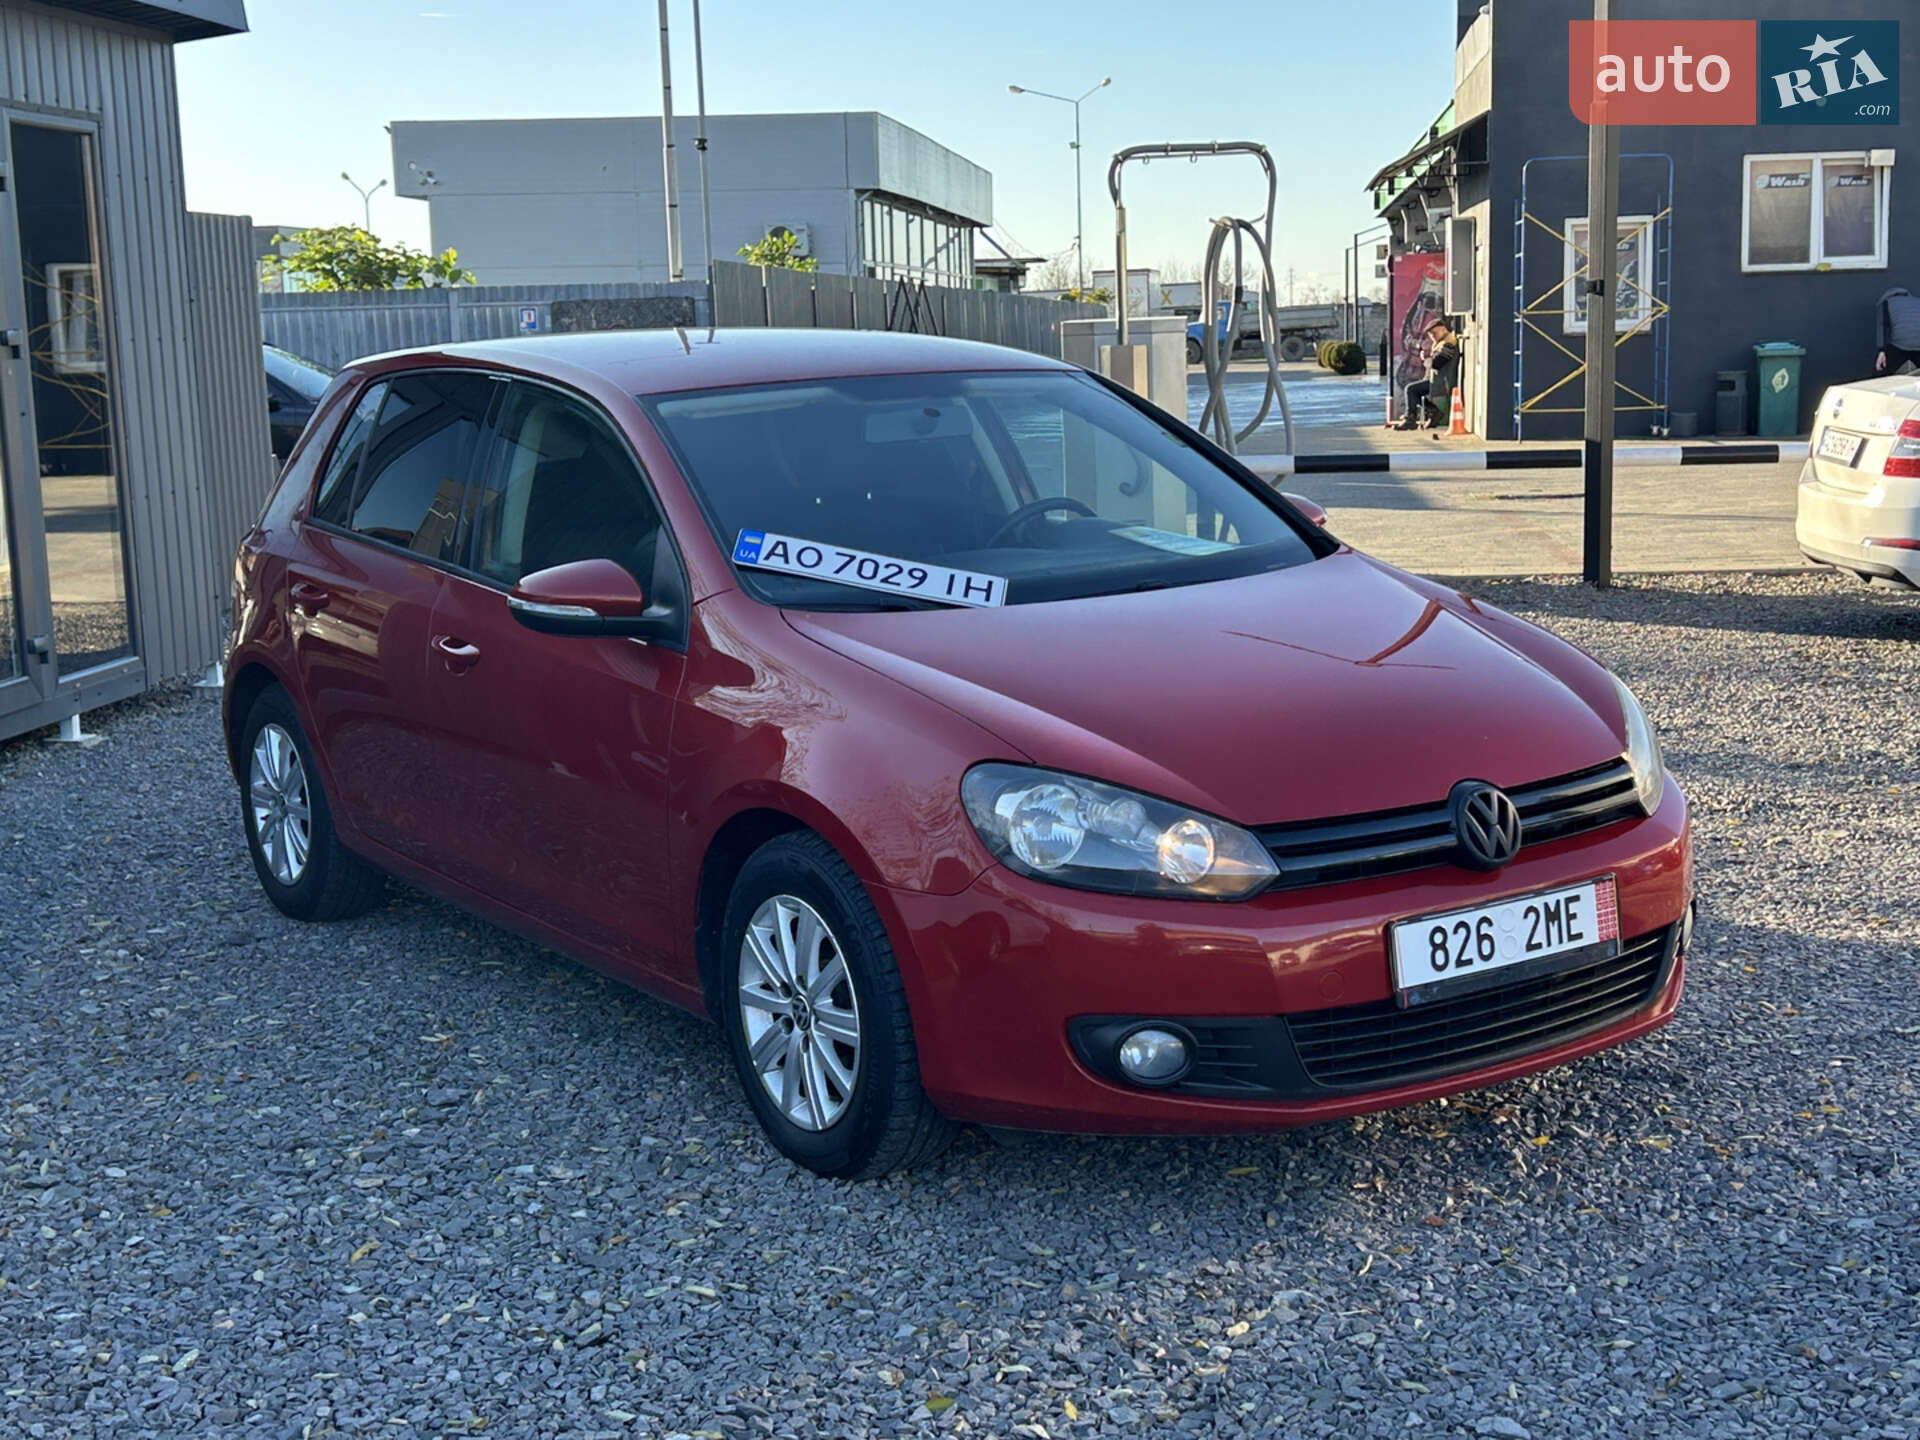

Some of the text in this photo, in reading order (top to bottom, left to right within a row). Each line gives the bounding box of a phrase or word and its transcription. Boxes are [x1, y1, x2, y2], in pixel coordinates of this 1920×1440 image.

[739, 549, 758, 560] UA
[763, 540, 994, 602] AO 7029 IH
[1428, 915, 1497, 972] 826
[1522, 894, 1584, 952] 2ME
